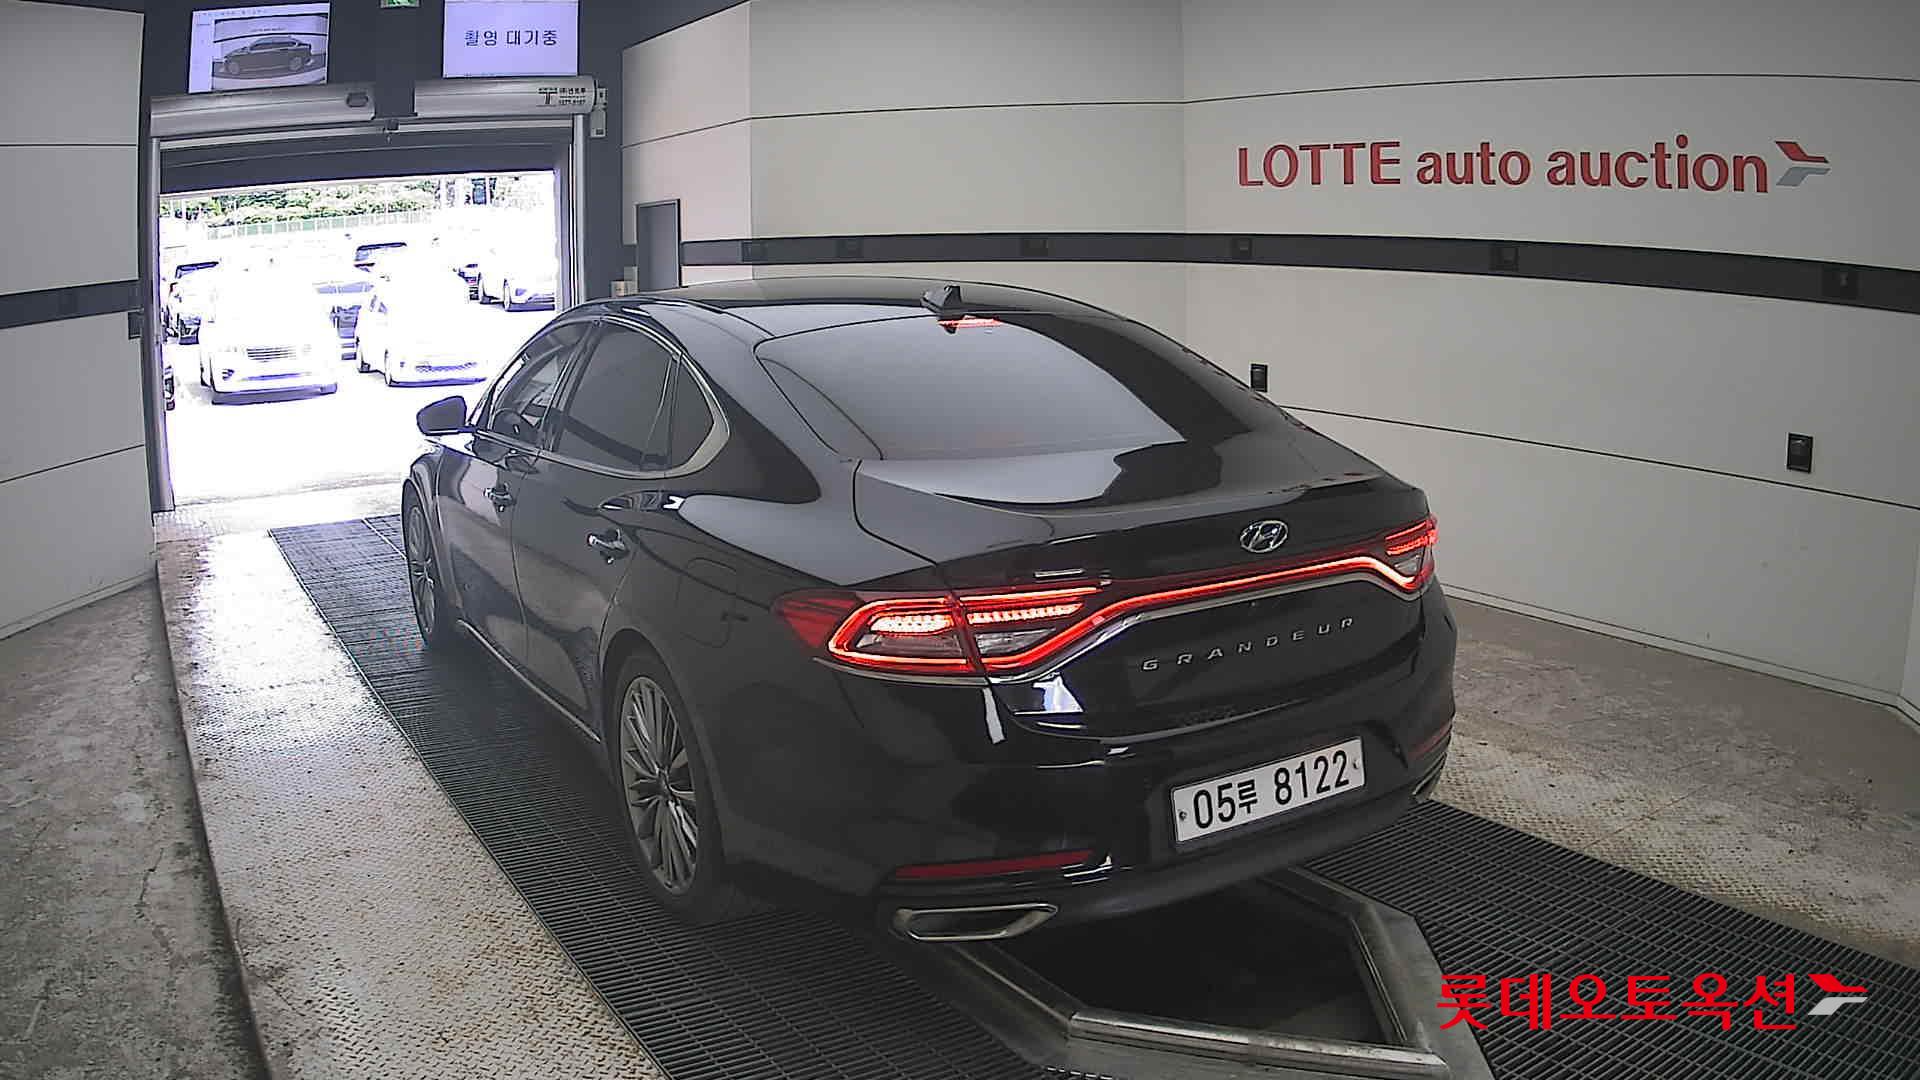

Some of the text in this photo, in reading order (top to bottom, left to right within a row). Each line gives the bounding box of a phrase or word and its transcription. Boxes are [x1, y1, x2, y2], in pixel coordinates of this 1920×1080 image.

[465, 30, 557, 46] 촬영 대기중
[1239, 134, 1769, 194] LOTTE auto auction
[1142, 617, 1353, 672] GRANDEUR
[1193, 749, 1350, 829] 05루 8122
